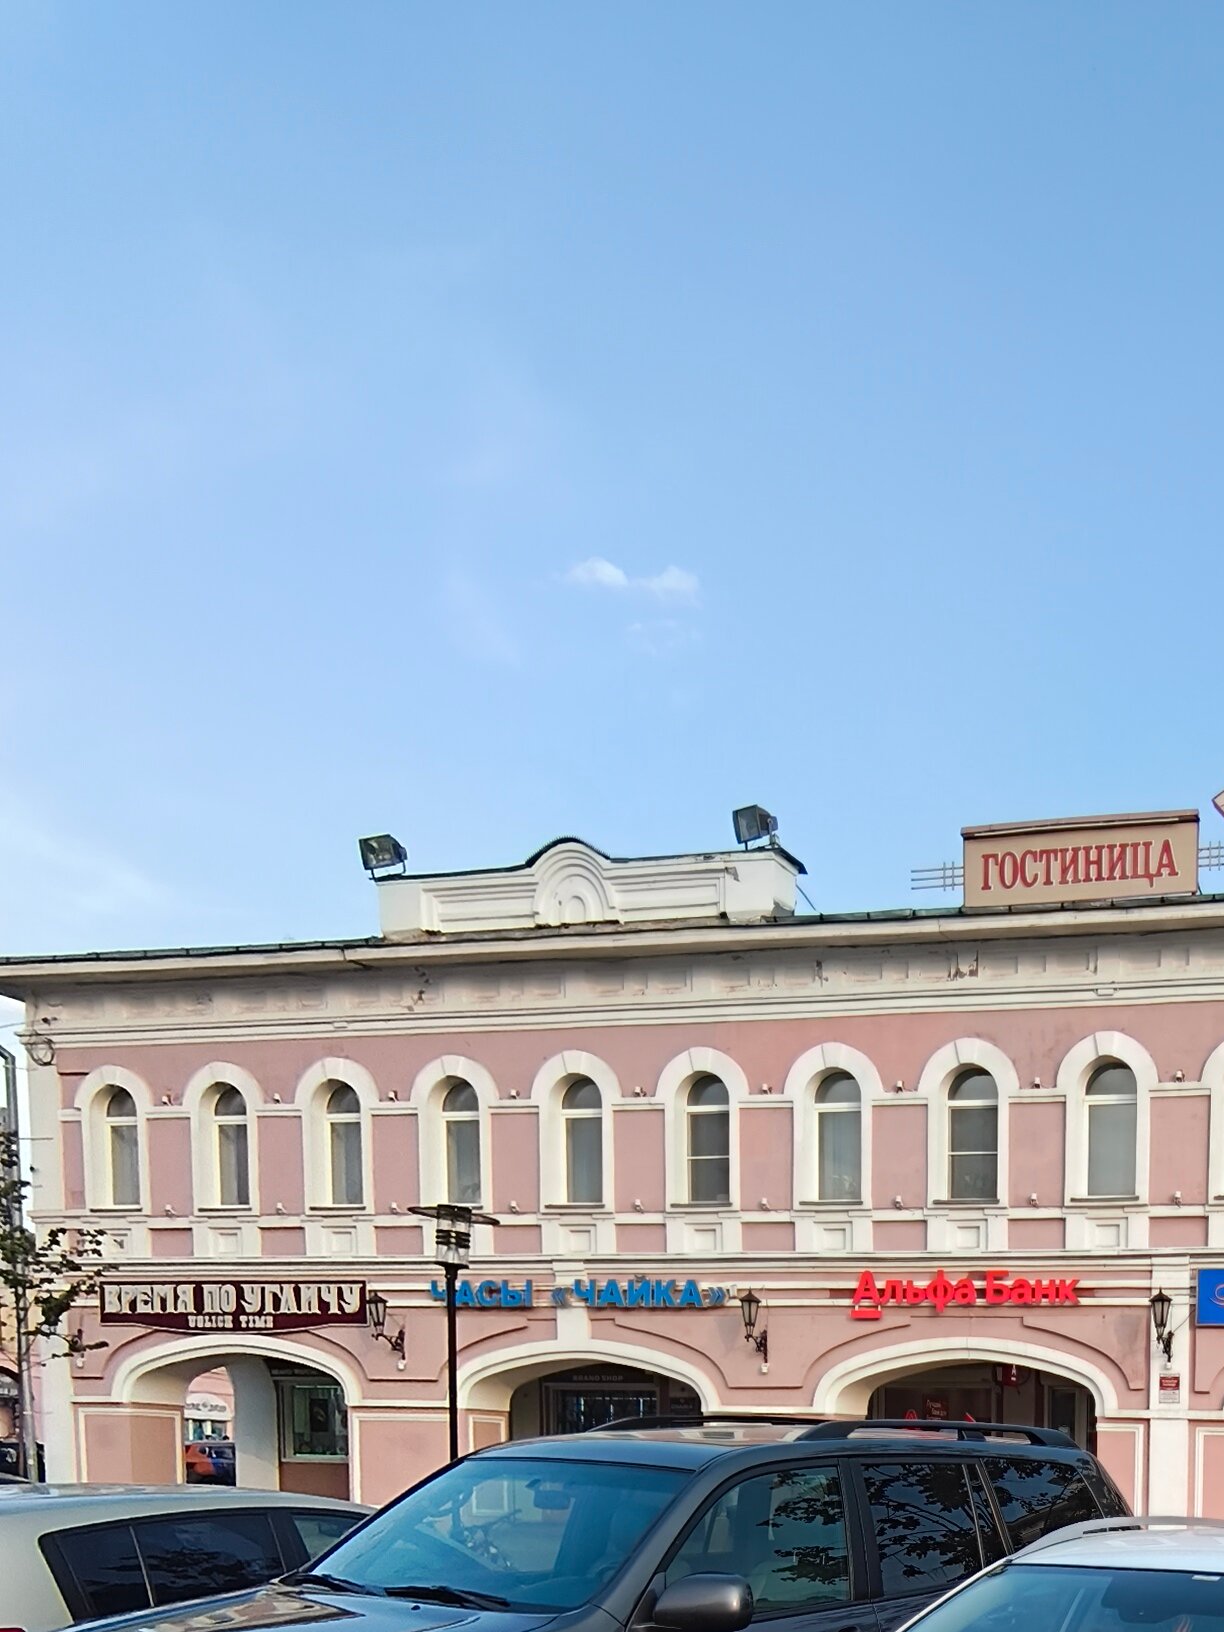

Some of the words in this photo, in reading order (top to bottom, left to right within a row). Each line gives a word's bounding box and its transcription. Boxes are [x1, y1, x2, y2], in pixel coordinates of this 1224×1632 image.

[980, 838, 1179, 891] ГОСТИНИЦА
[103, 1284, 196, 1314] ВРЕМЯ
[201, 1284, 237, 1314] ПО
[240, 1283, 363, 1314] УГЛИЧУ
[853, 1269, 977, 1314] Альфа
[985, 1270, 1081, 1305] Банк
[239, 1315, 274, 1328] TIME
